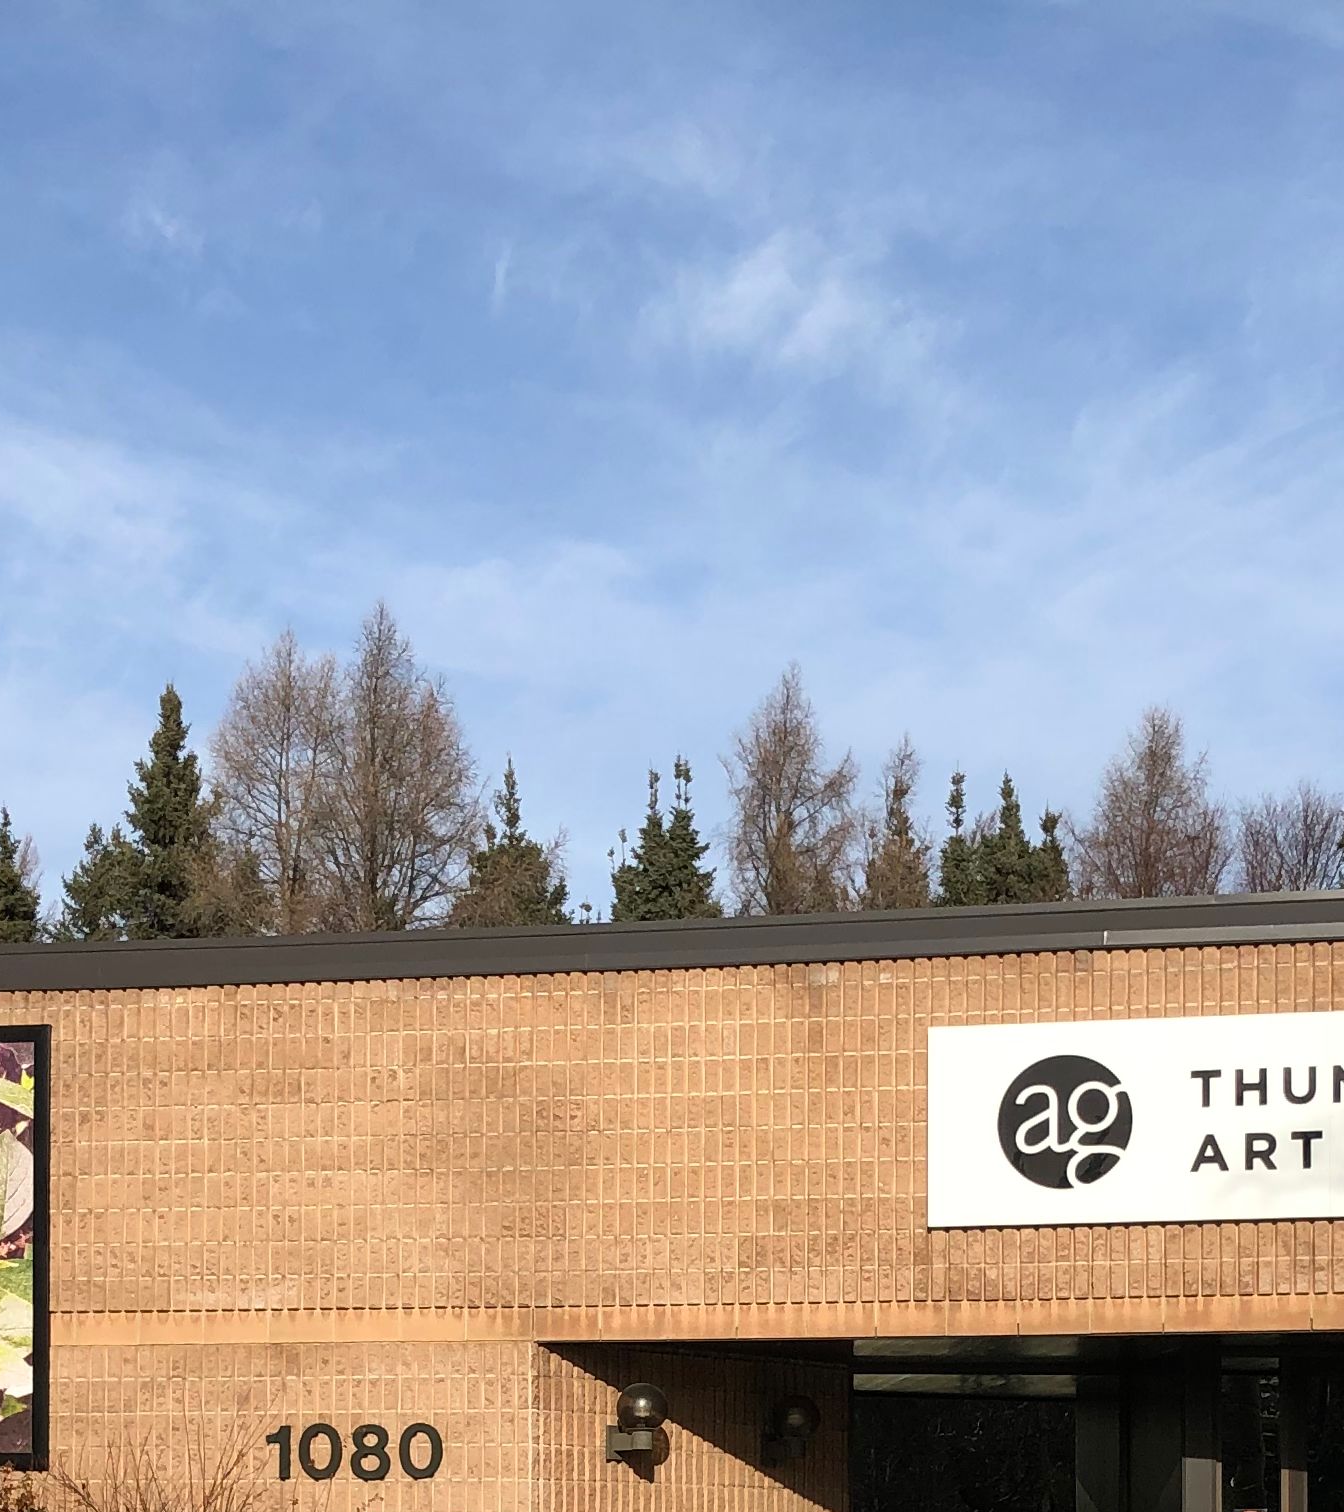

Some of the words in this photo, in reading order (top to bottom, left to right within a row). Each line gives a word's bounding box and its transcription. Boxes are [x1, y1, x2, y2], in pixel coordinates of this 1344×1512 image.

[1014, 1080, 1127, 1189] ag
[1191, 1130, 1323, 1172] ART
[265, 1422, 444, 1483] 1080
